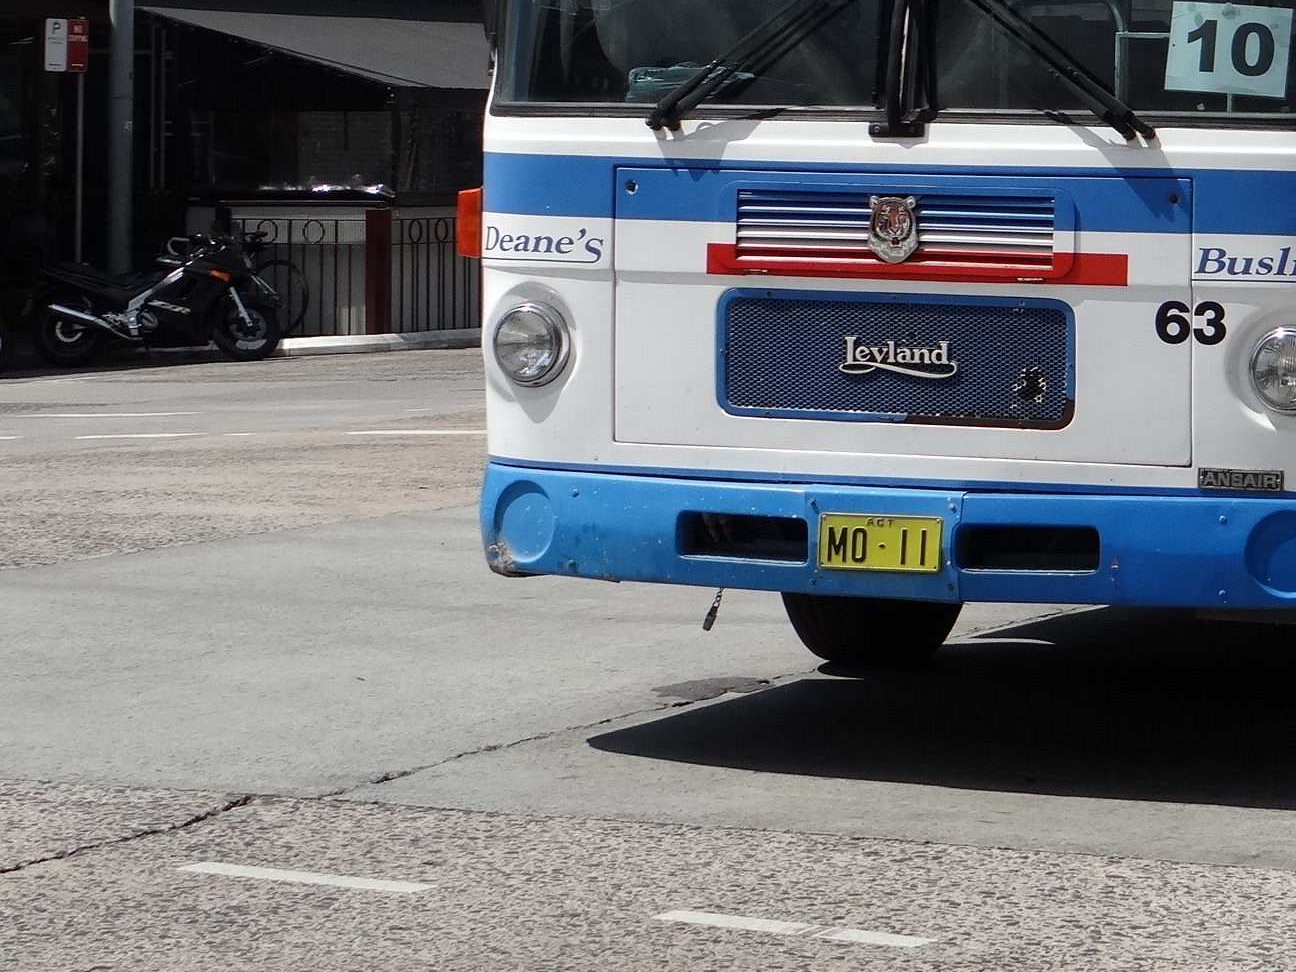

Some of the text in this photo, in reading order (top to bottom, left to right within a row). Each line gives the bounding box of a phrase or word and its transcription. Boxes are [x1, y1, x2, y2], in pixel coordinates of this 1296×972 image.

[1187, 19, 1275, 77] 10
[485, 226, 604, 263] Deane's
[1155, 300, 1227, 345] 63
[839, 335, 957, 378] Leyland
[1203, 471, 1277, 489] ANSAIR
[866, 518, 894, 528] ACT
